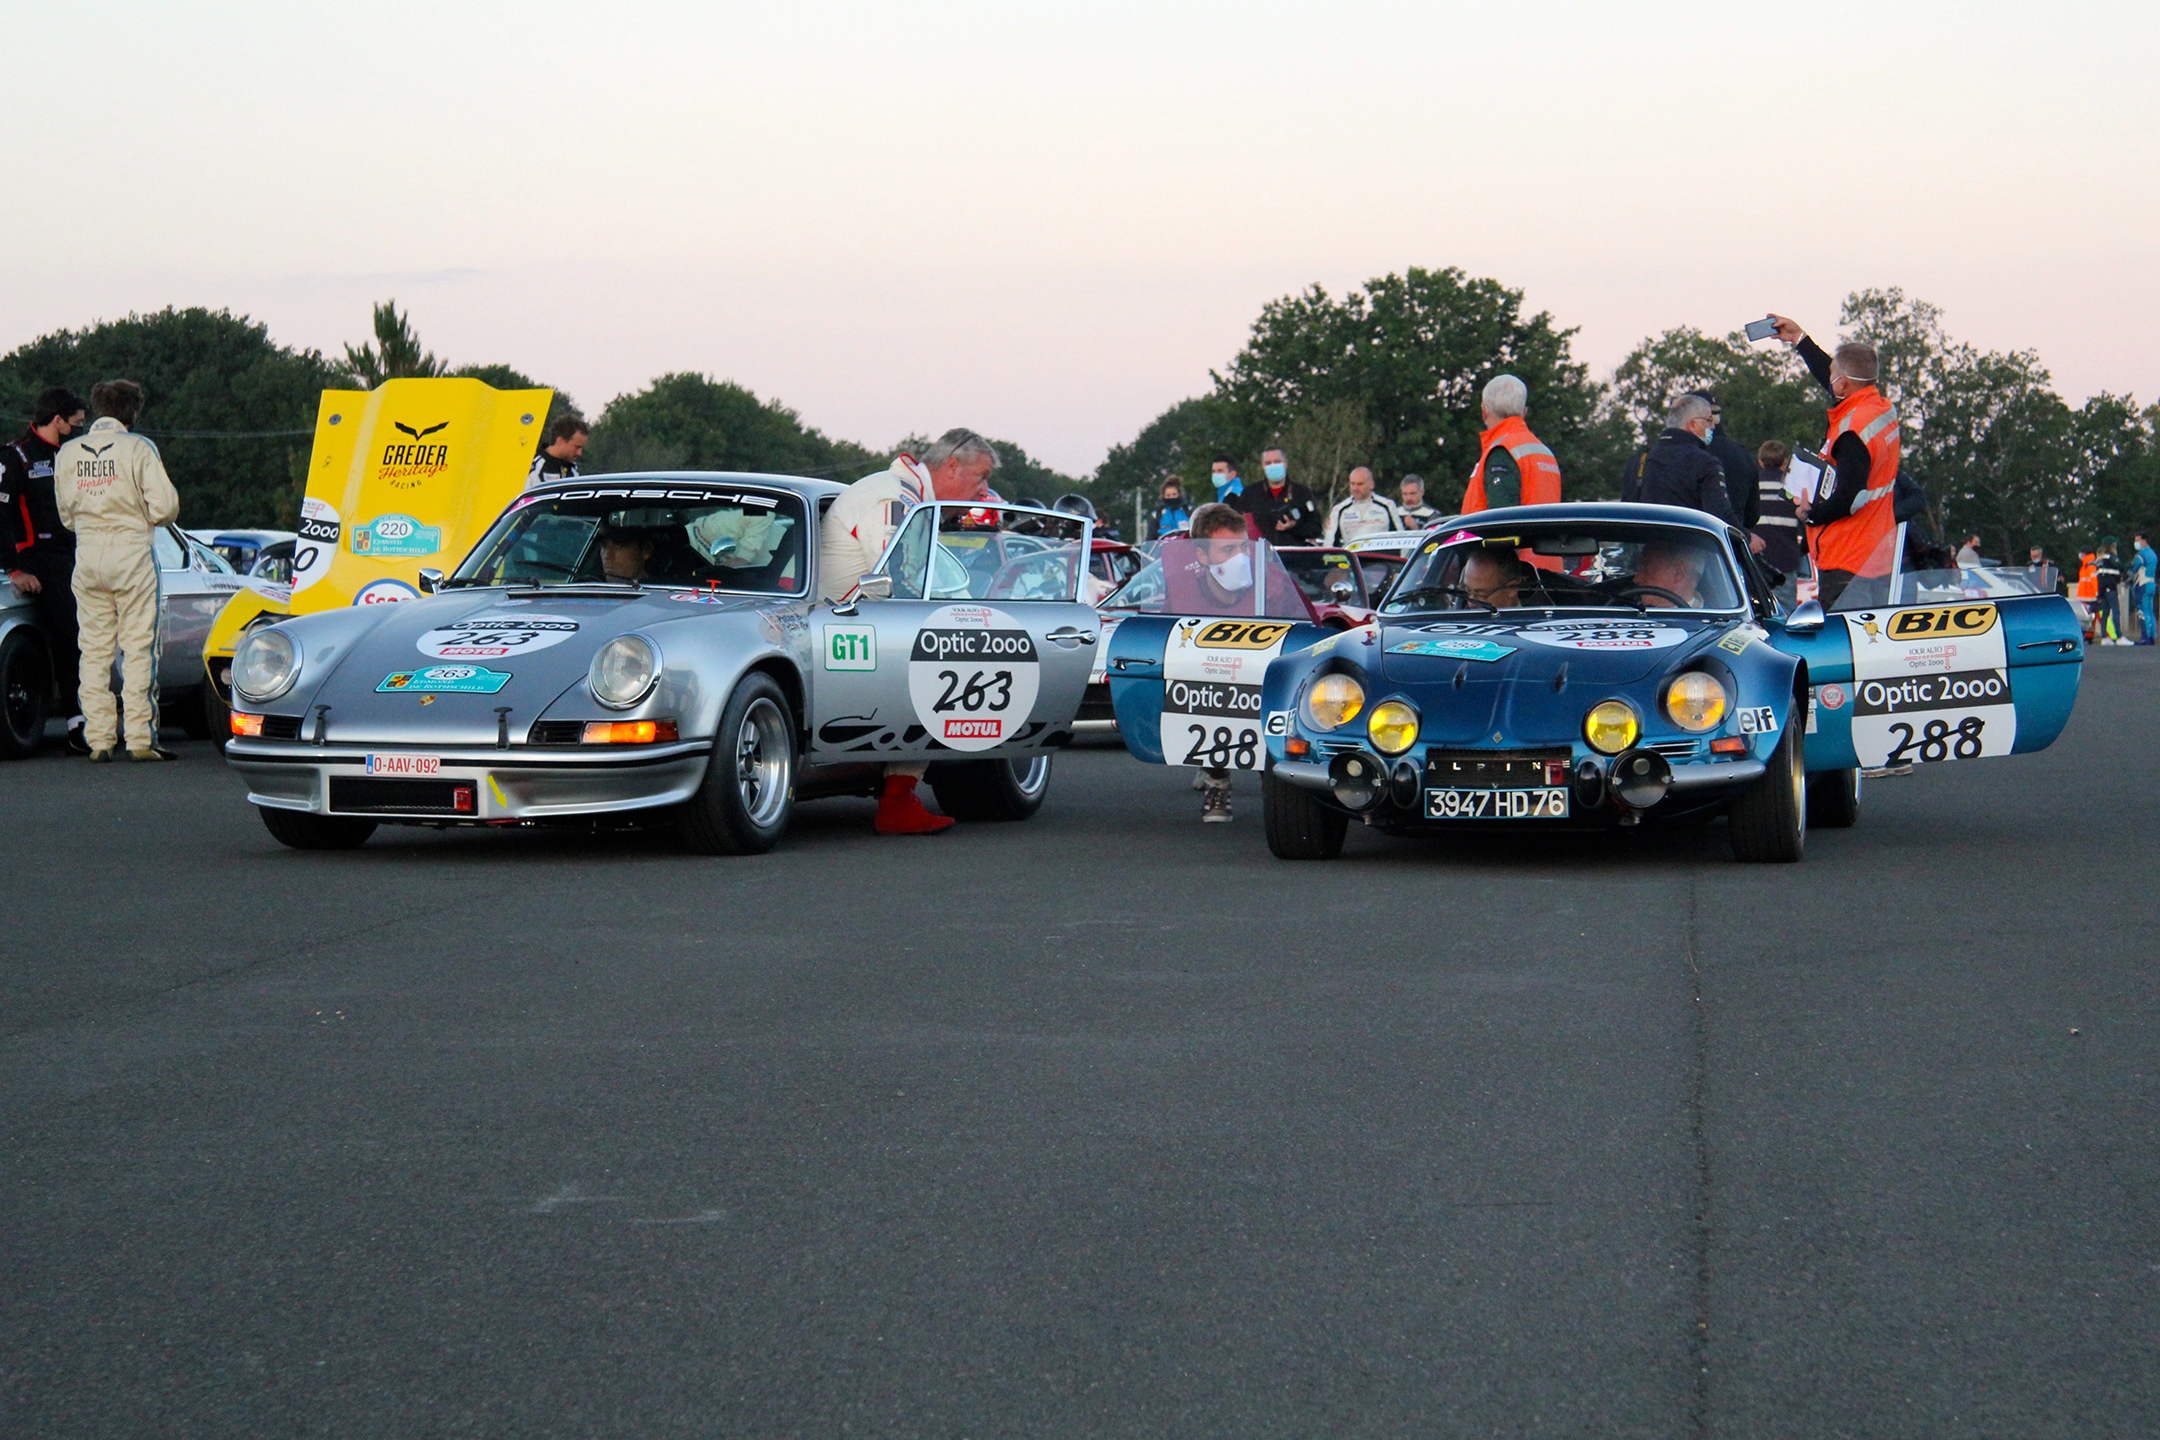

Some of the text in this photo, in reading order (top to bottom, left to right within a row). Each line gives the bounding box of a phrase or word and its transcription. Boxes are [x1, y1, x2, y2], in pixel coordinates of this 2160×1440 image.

[382, 445, 448, 465] GREDER
[77, 460, 115, 477] GREDER
[378, 463, 448, 480] Heritage
[77, 474, 119, 490] Hertage
[390, 480, 422, 489] RACING
[534, 489, 779, 508] PORSCHE
[300, 519, 339, 539] 2000
[380, 522, 408, 536] 220
[452, 621, 576, 631] Optic 2000
[1526, 622, 1597, 631] Optic
[436, 631, 540, 646] 263
[1556, 630, 1656, 641] 288
[832, 633, 869, 660] GT1
[920, 631, 1031, 660] Optic 2000
[1925, 646, 1943, 654] AUTO
[1206, 655, 1219, 663] TOUR
[1909, 660, 1927, 668] Optic
[429, 669, 470, 678] 263
[1204, 667, 1219, 675] Optic
[932, 670, 1013, 714] 263
[1172, 682, 1262, 713] Optic 200
[1863, 676, 2001, 712] Optic 2000
[946, 722, 999, 736] MOTUL
[1740, 708, 1772, 733] elf
[1183, 724, 1258, 769] 288
[1885, 716, 1985, 767] 288
[1430, 790, 1564, 817] 3947 HD 76
